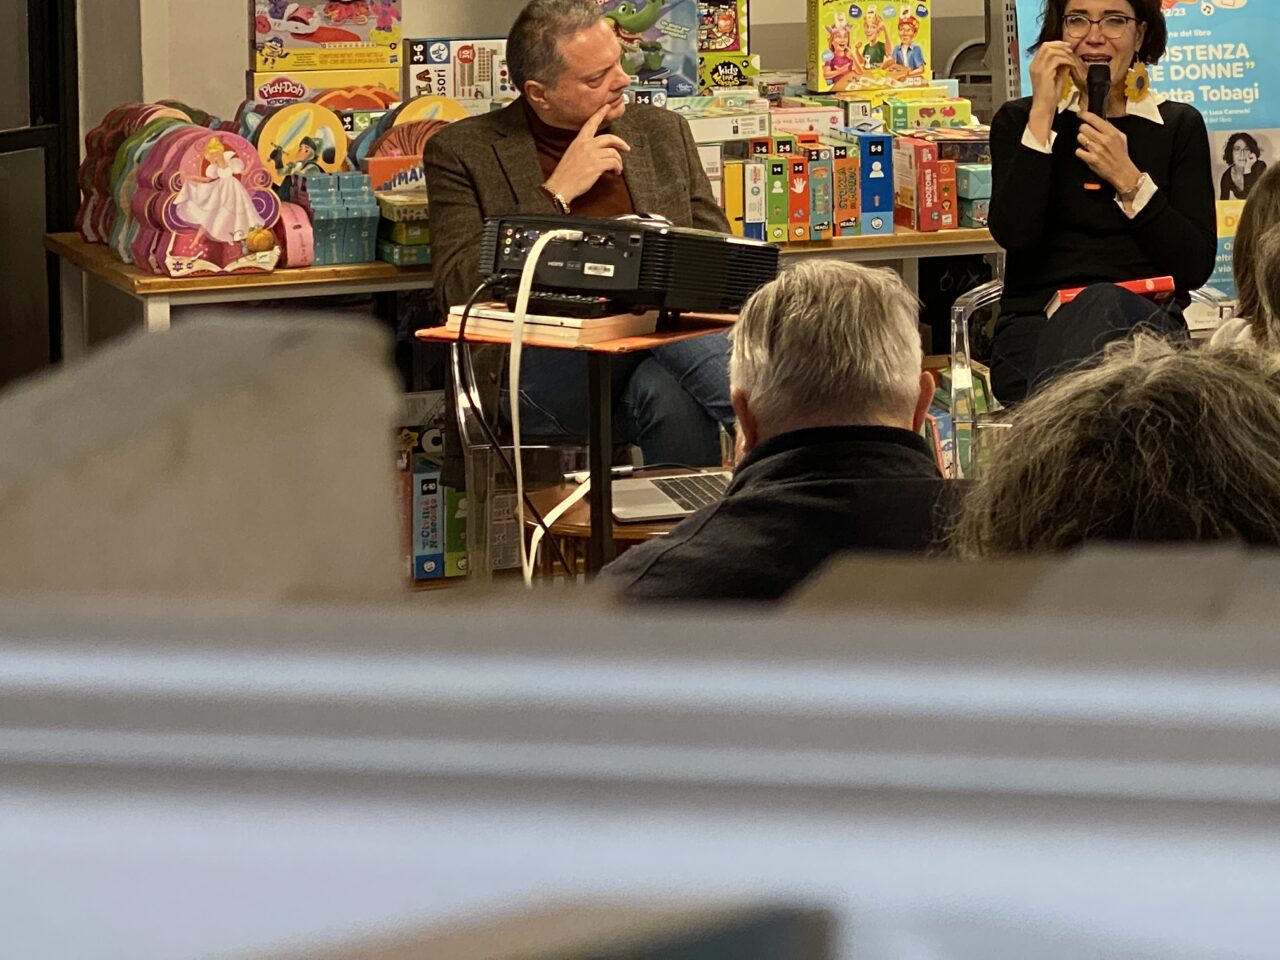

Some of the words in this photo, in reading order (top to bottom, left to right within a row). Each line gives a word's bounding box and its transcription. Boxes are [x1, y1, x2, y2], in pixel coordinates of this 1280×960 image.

[413, 43, 424, 62] 3-6
[717, 64, 739, 76] kids
[636, 95, 650, 105] 3-6
[1198, 82, 1260, 104] Tobagi
